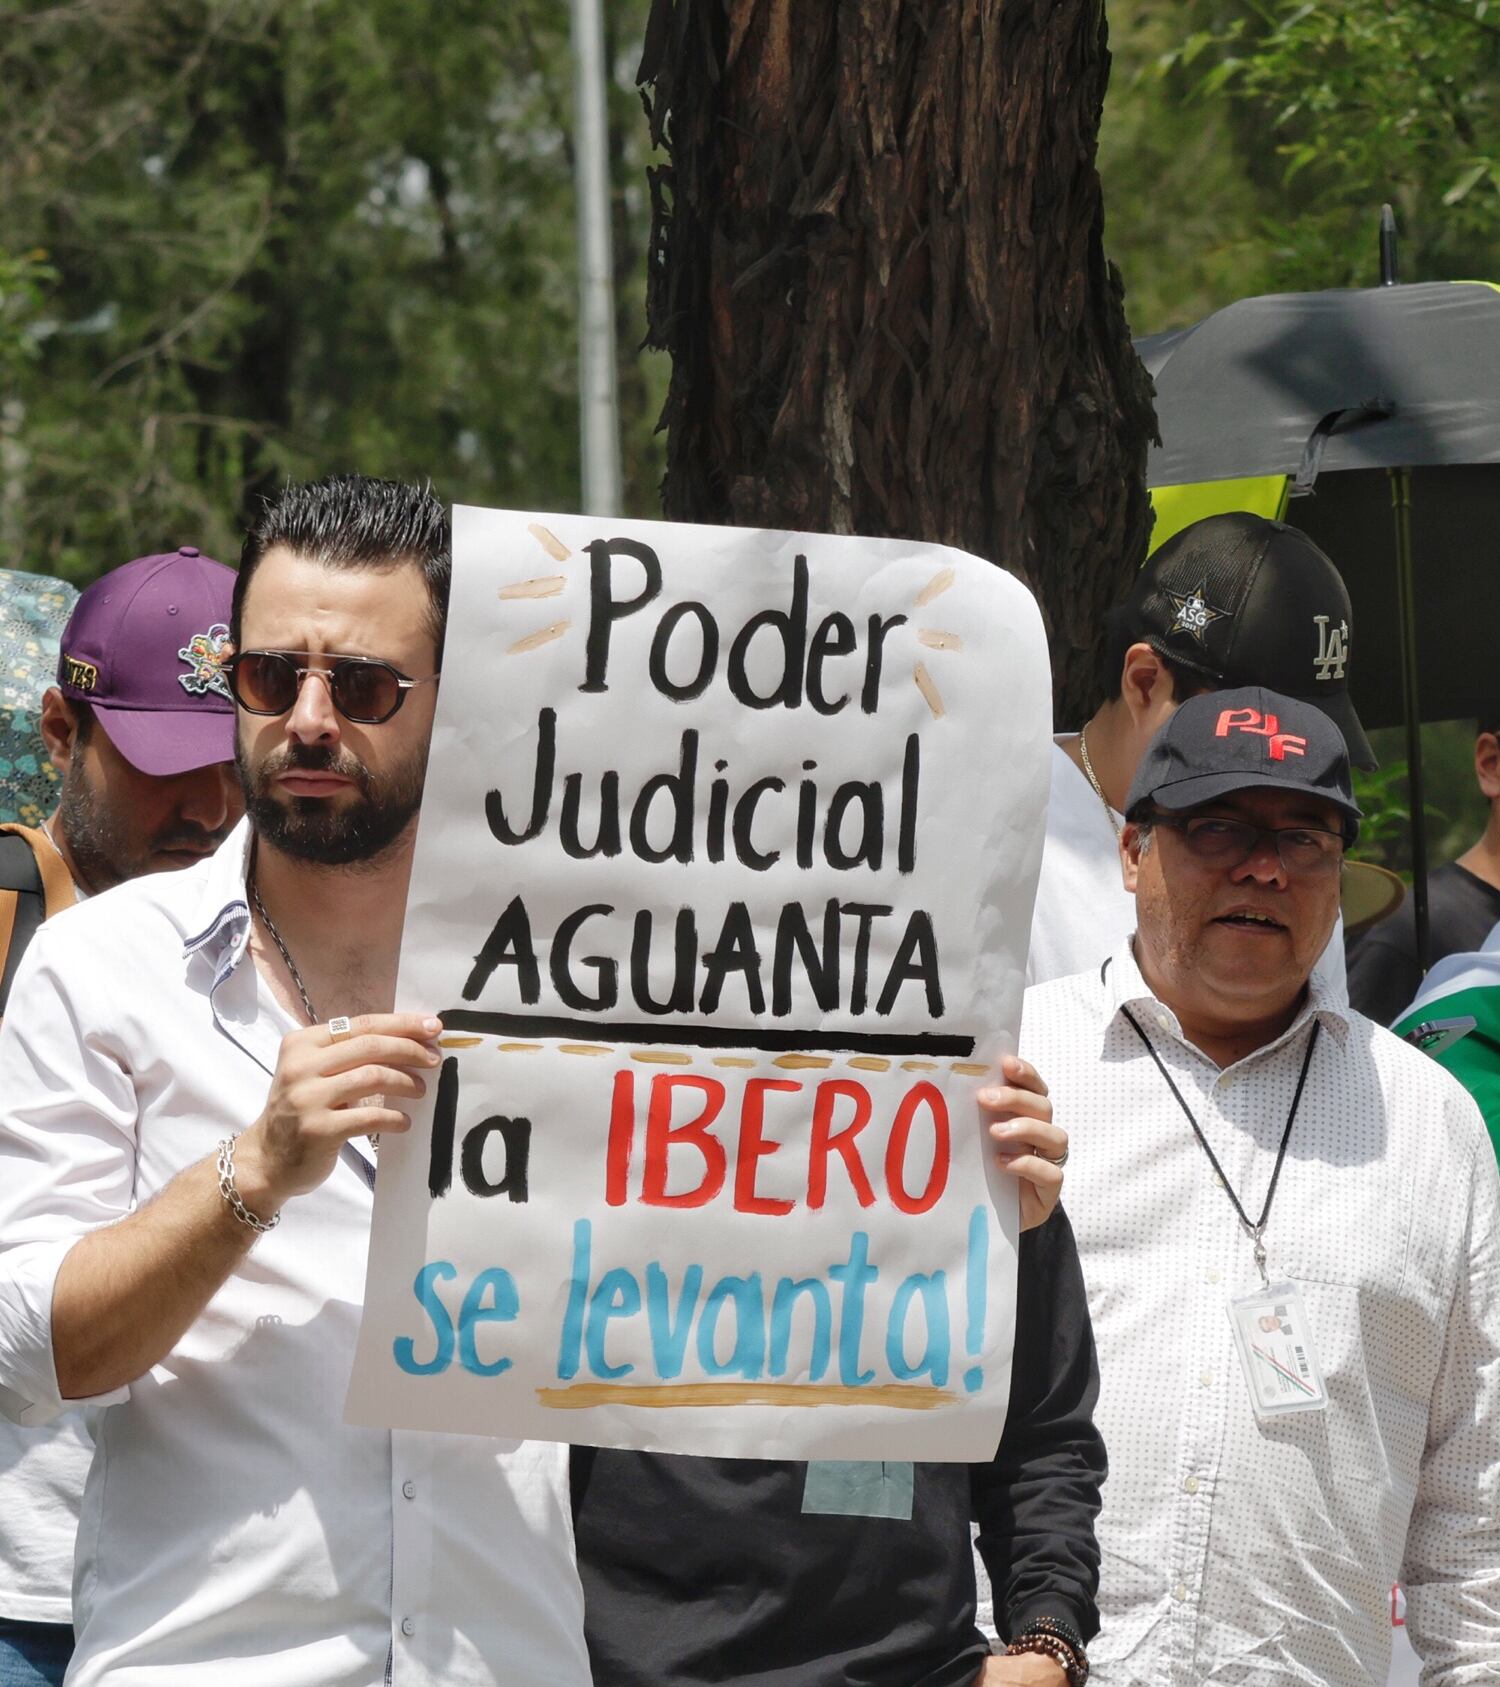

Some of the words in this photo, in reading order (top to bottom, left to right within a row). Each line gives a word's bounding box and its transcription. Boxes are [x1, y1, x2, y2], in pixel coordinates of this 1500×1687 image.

[579, 537, 909, 716] Poder
[1177, 606, 1206, 626] ASG
[484, 707, 920, 875] Judicial
[461, 894, 945, 1019] AGUANTA
[428, 1056, 531, 1202] la
[605, 1070, 950, 1216] IBERO
[393, 1260, 521, 1377] se
[557, 1204, 989, 1393] levanta!
